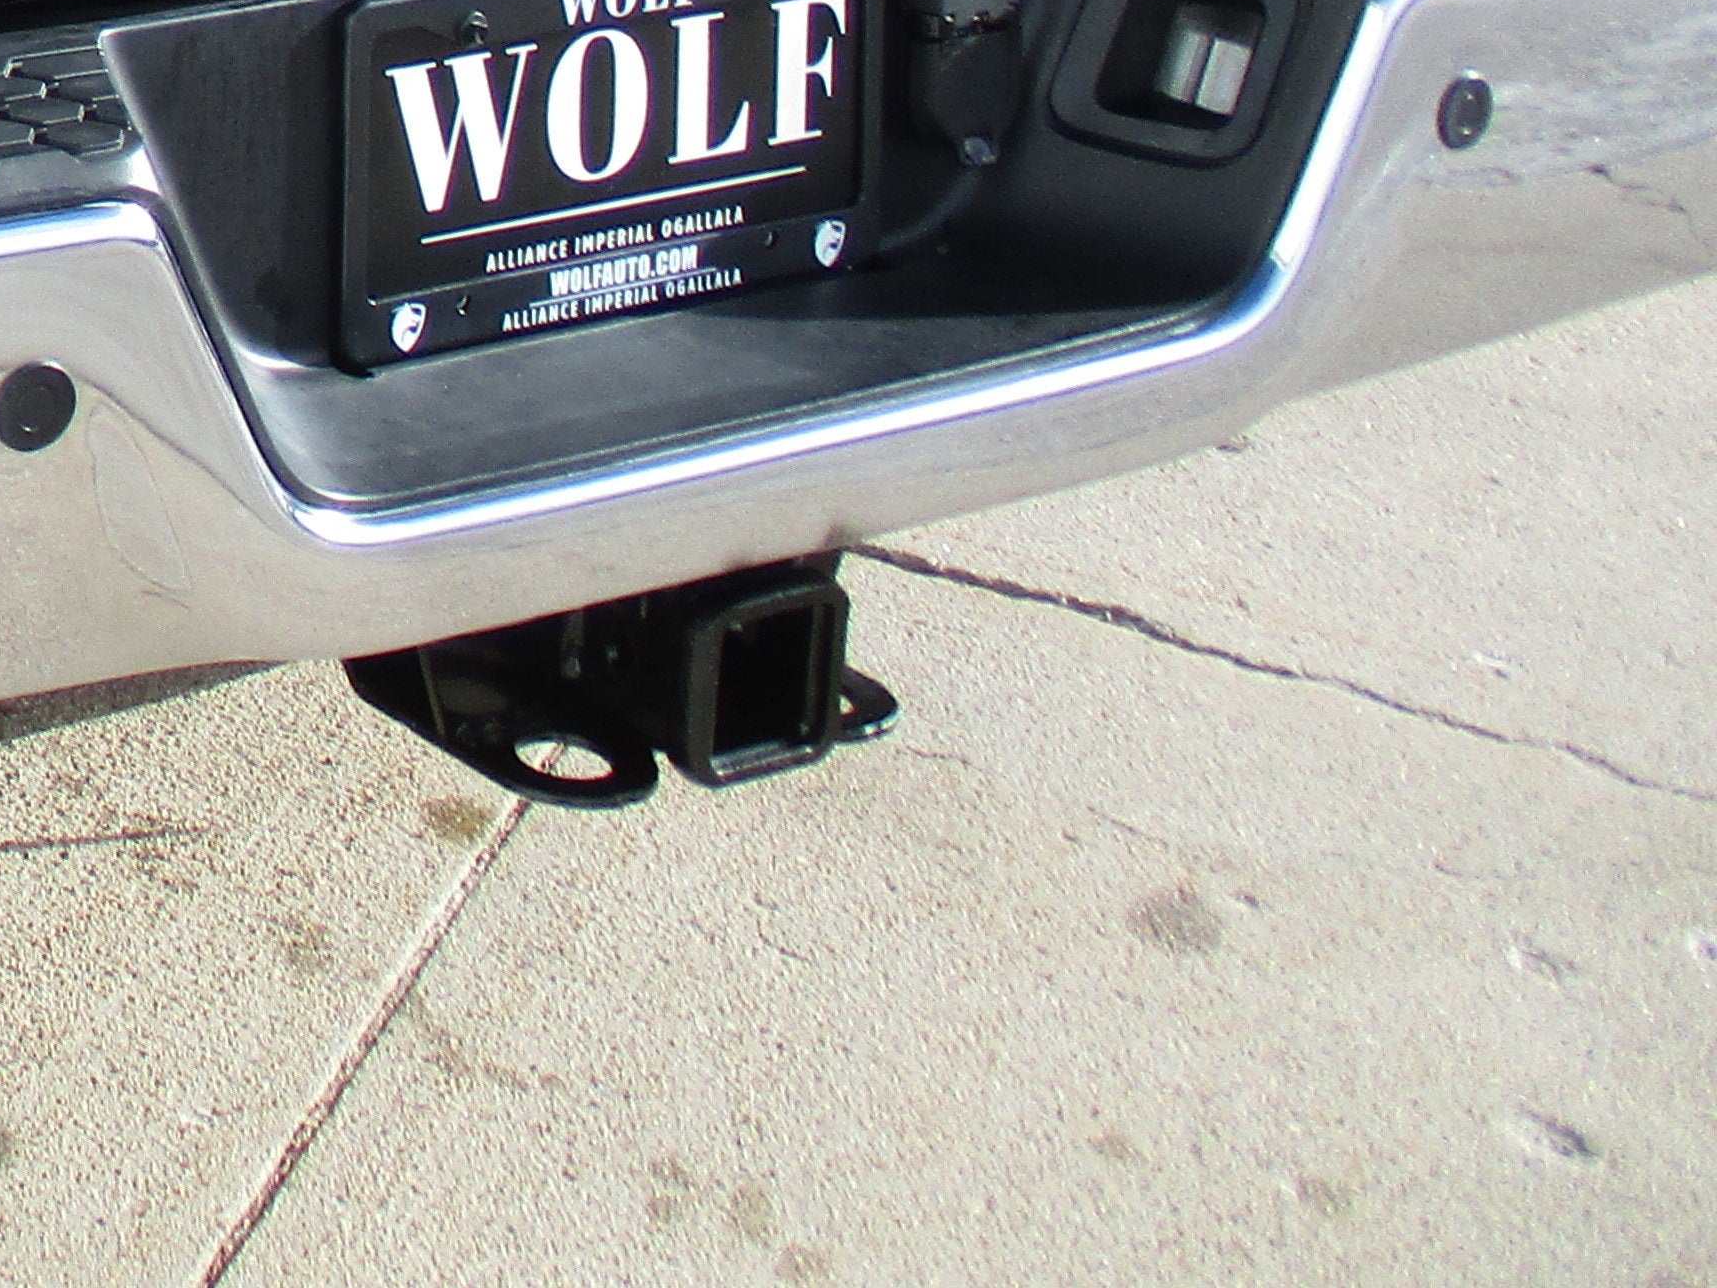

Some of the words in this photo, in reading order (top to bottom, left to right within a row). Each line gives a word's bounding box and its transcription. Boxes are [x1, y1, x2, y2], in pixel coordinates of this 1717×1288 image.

[485, 239, 569, 273] ALLIANCE
[574, 223, 655, 256] IMPERIAL
[661, 205, 745, 238] OGALLALA
[549, 244, 700, 297] WOLFAUTO.COM
[502, 300, 579, 332] ALLIANCE
[584, 284, 659, 315] IMPERIAL
[665, 268, 743, 299] OGALLALA
